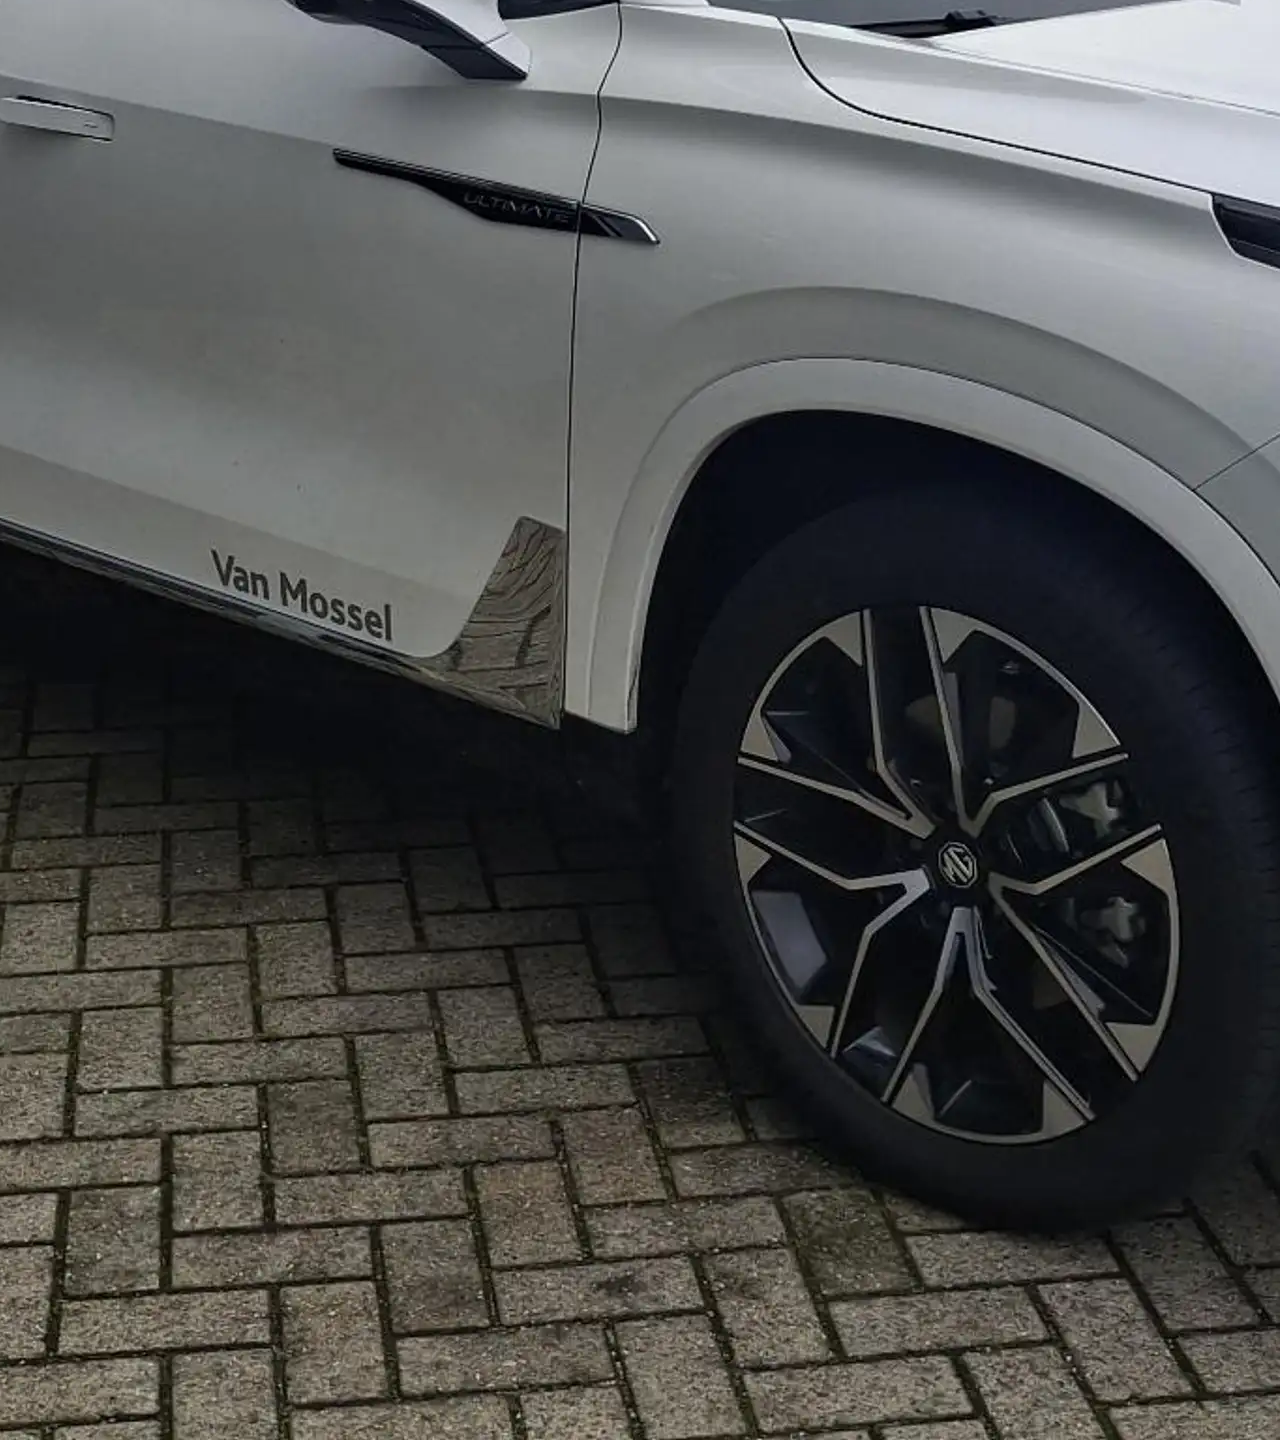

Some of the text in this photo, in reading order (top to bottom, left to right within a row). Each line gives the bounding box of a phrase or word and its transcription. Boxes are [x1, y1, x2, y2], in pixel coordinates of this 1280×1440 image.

[210, 548, 392, 642] Van Mossel
[941, 845, 975, 885] MG
